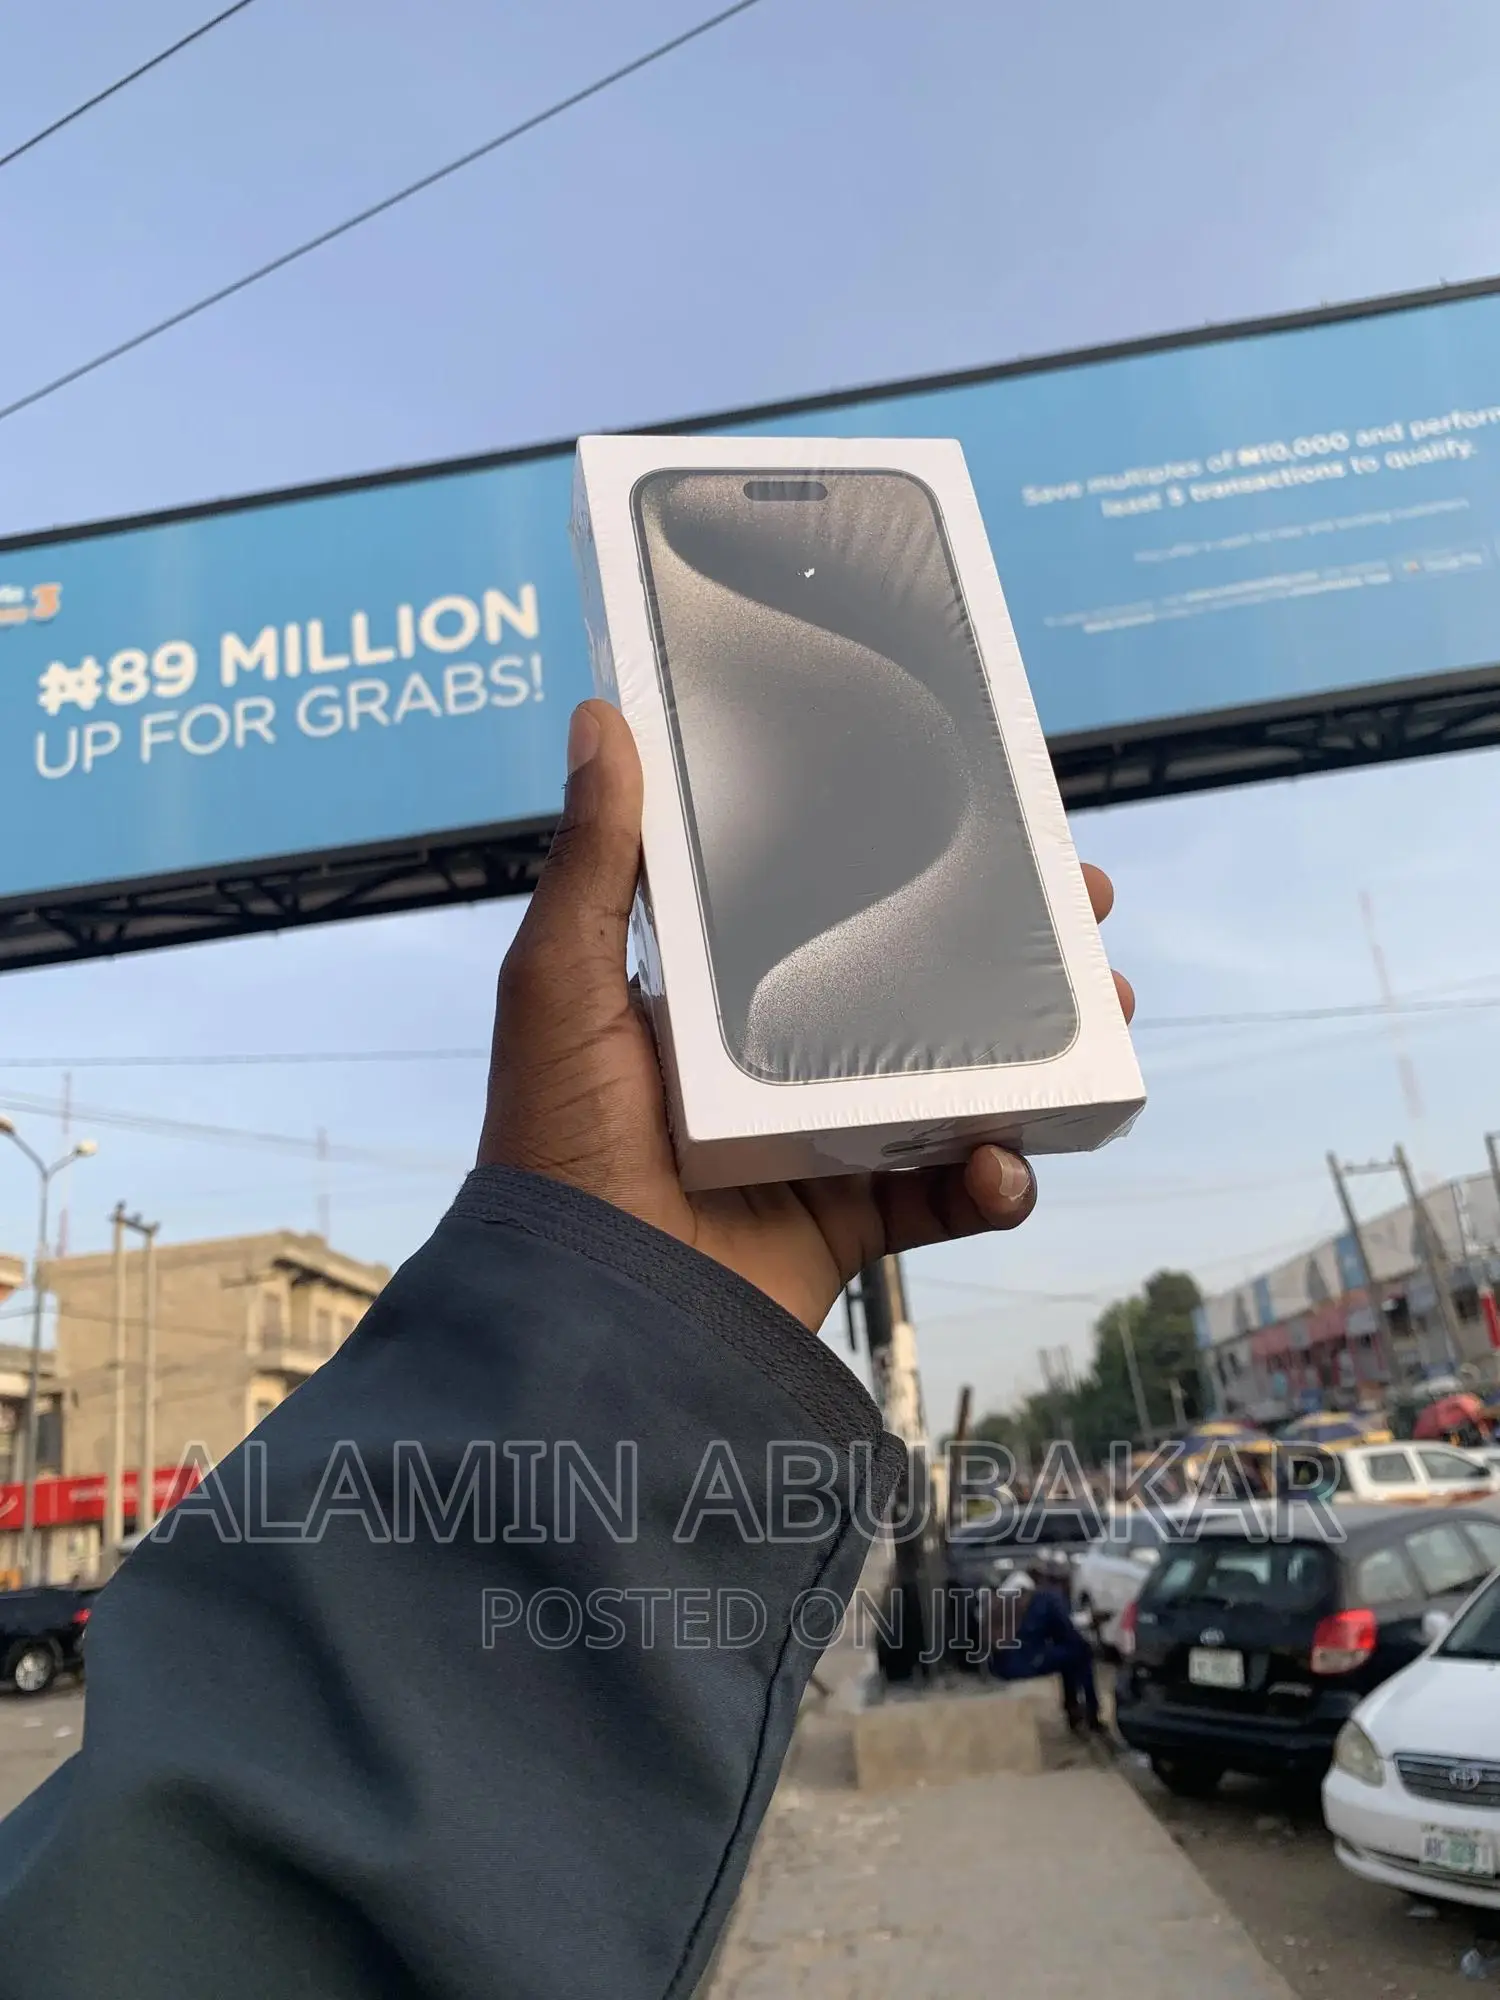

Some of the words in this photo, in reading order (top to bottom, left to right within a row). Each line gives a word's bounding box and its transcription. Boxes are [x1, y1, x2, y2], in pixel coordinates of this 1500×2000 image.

[1022, 482, 1082, 507] Save
[1087, 459, 1202, 493] multiples
[1206, 449, 1234, 474] of
[1356, 421, 1404, 448] and
[1101, 493, 1162, 518] least
[1189, 461, 1346, 502] transactions
[1350, 454, 1381, 475] to
[220, 583, 541, 688] MILLION
[35, 721, 122, 780] UP
[140, 696, 276, 764] FOR
[296, 651, 546, 739] GRABS!
